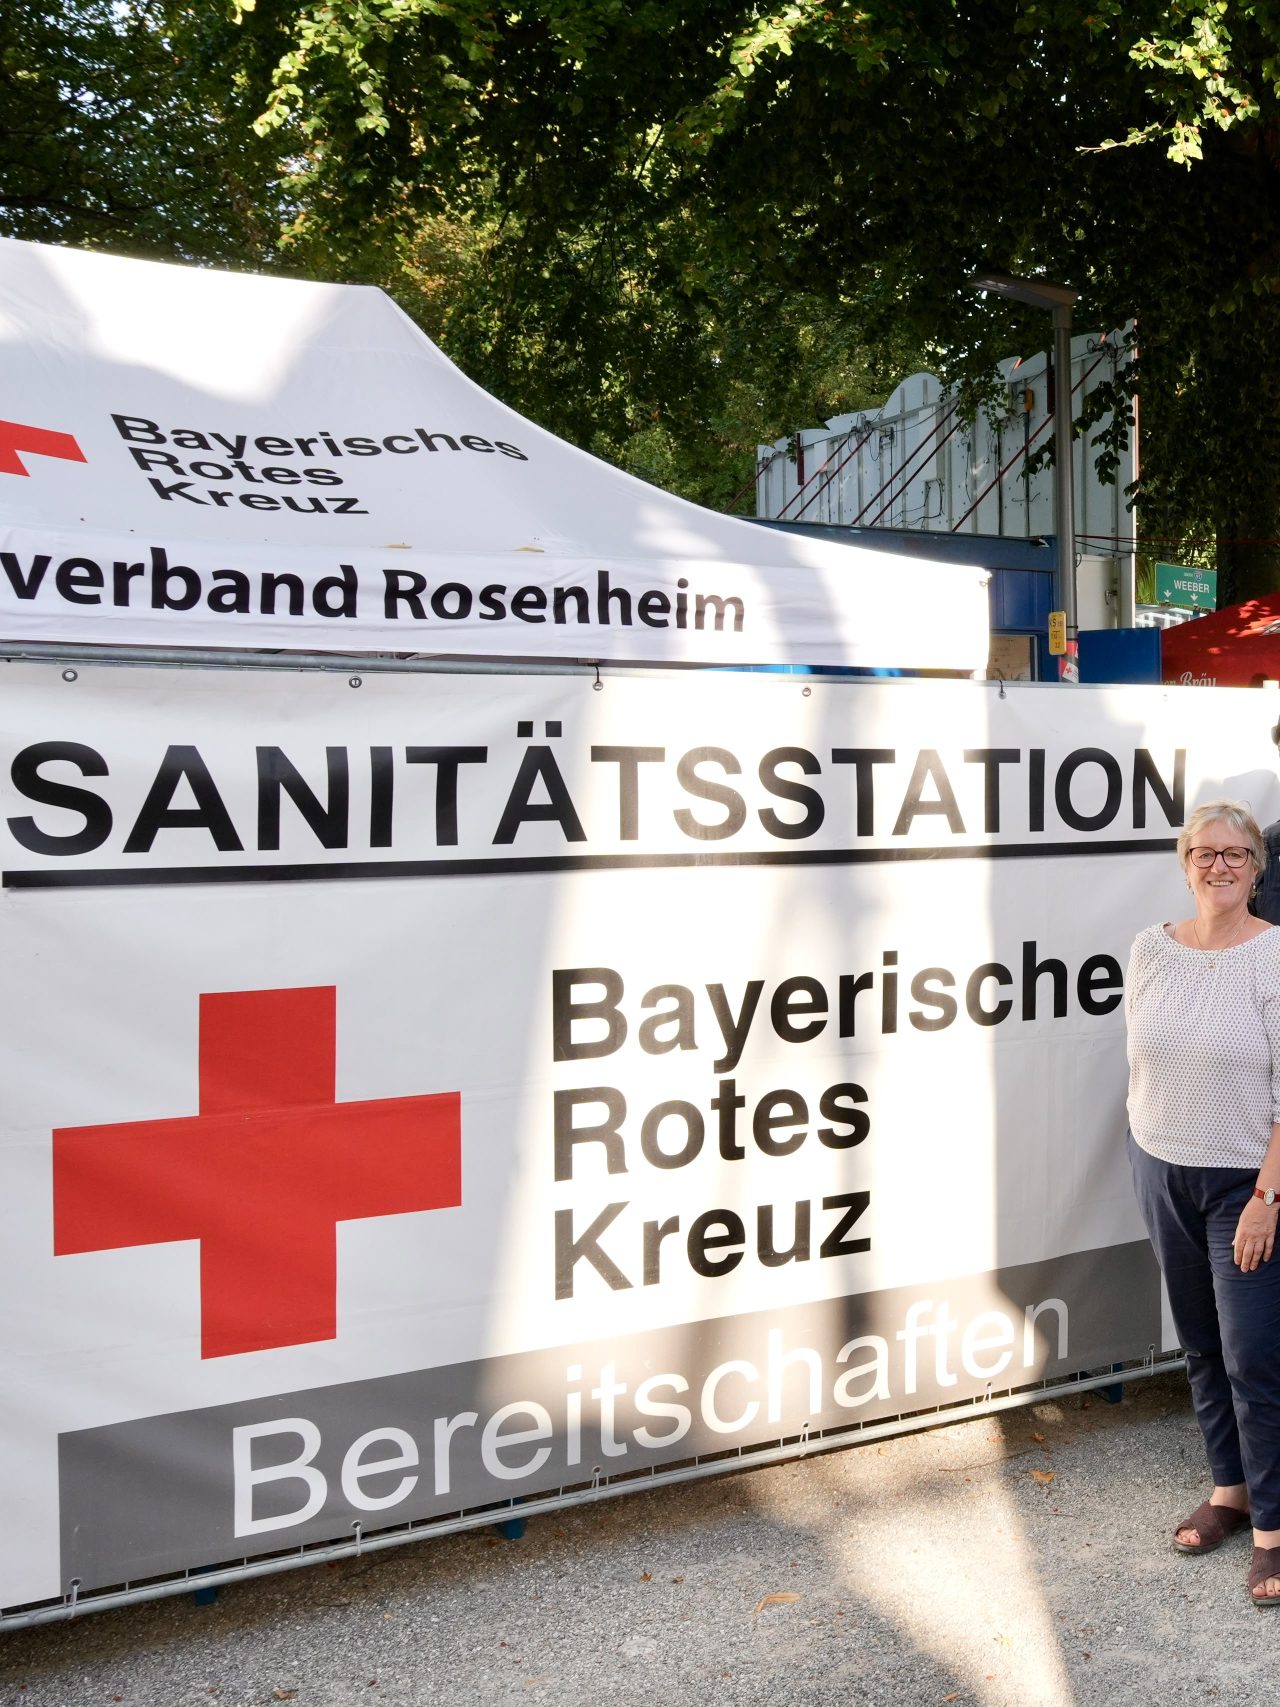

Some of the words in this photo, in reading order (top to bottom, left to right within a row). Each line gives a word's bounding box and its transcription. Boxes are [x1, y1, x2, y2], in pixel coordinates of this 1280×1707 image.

[111, 413, 529, 462] Bayerisches
[129, 447, 344, 486] Rotes
[147, 478, 369, 515] Kreuz
[0, 547, 357, 619] verband
[383, 568, 745, 633] Rosenheim
[1173, 579, 1210, 594] WEEBER
[7, 720, 1187, 857] SANITÄTSSTATION
[552, 1080, 873, 1182] Rotes
[552, 1190, 873, 1300] Kreuz
[231, 1297, 1070, 1538] Bereitschaften
